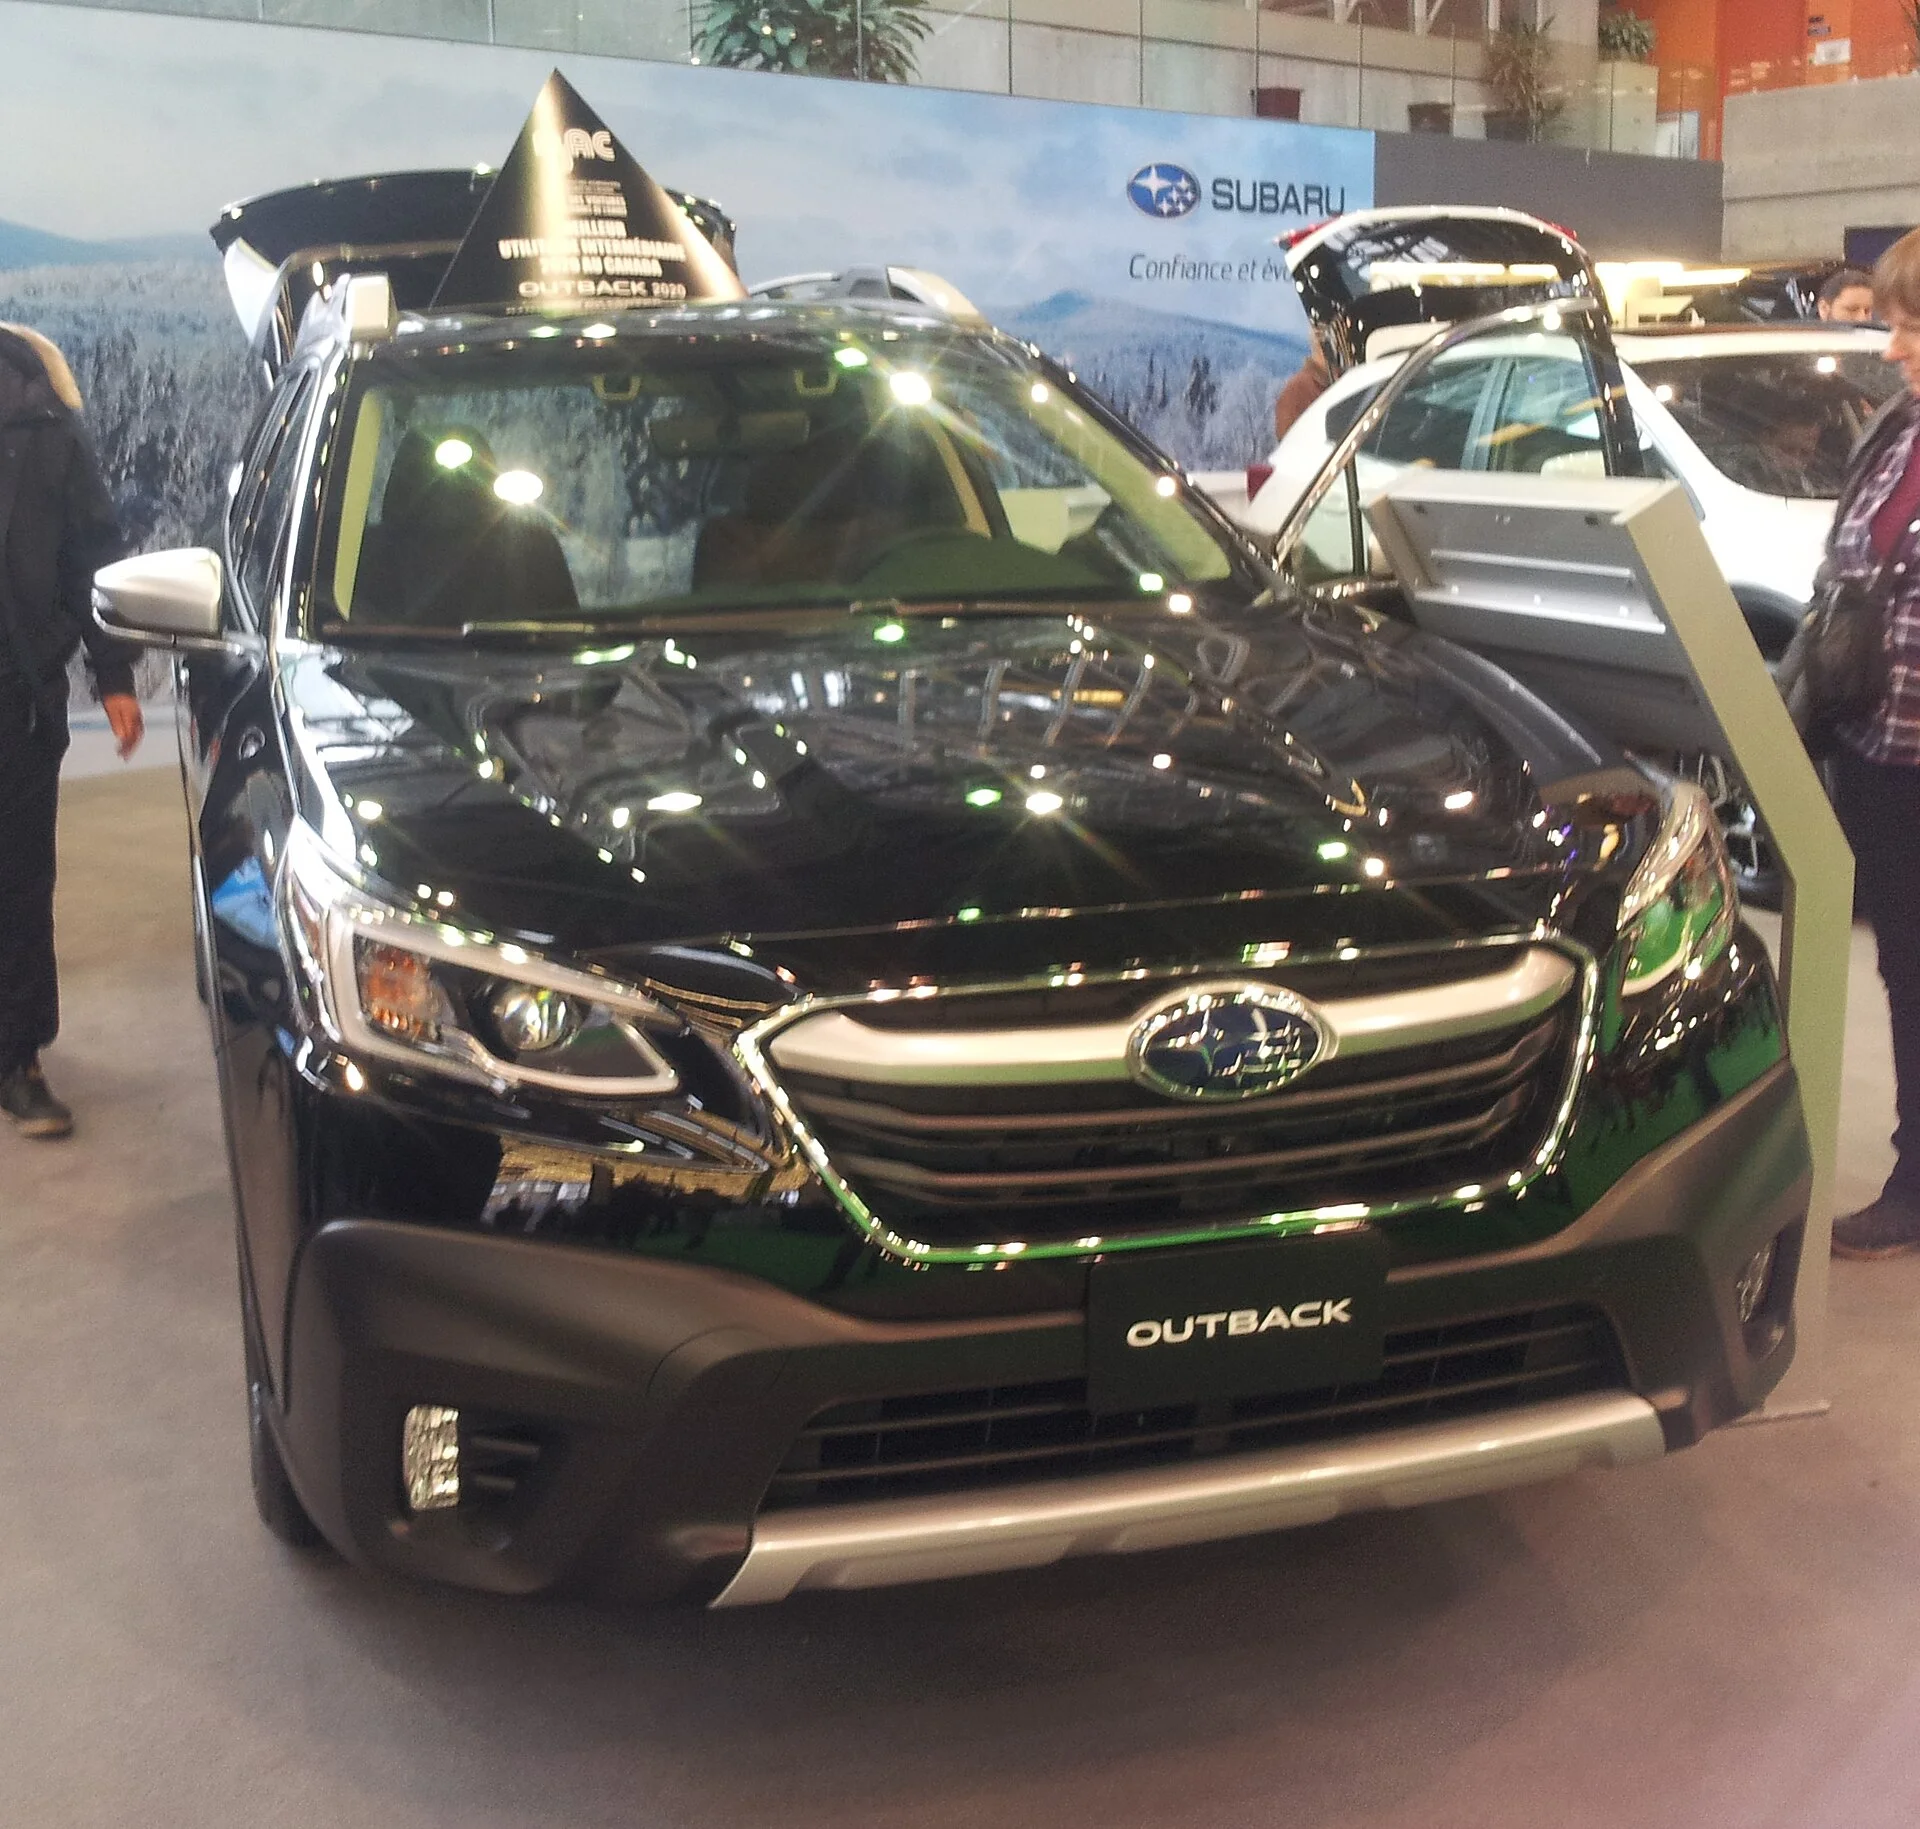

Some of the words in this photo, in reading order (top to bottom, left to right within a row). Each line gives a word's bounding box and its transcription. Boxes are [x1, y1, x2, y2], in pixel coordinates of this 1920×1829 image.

[1212, 178, 1345, 216] SUBARU
[1129, 254, 1231, 282] Confiance
[1237, 258, 1256, 282] et
[518, 280, 648, 298] OUTBACK
[651, 282, 687, 300] 2020
[1126, 1297, 1353, 1348] OUTBACK
